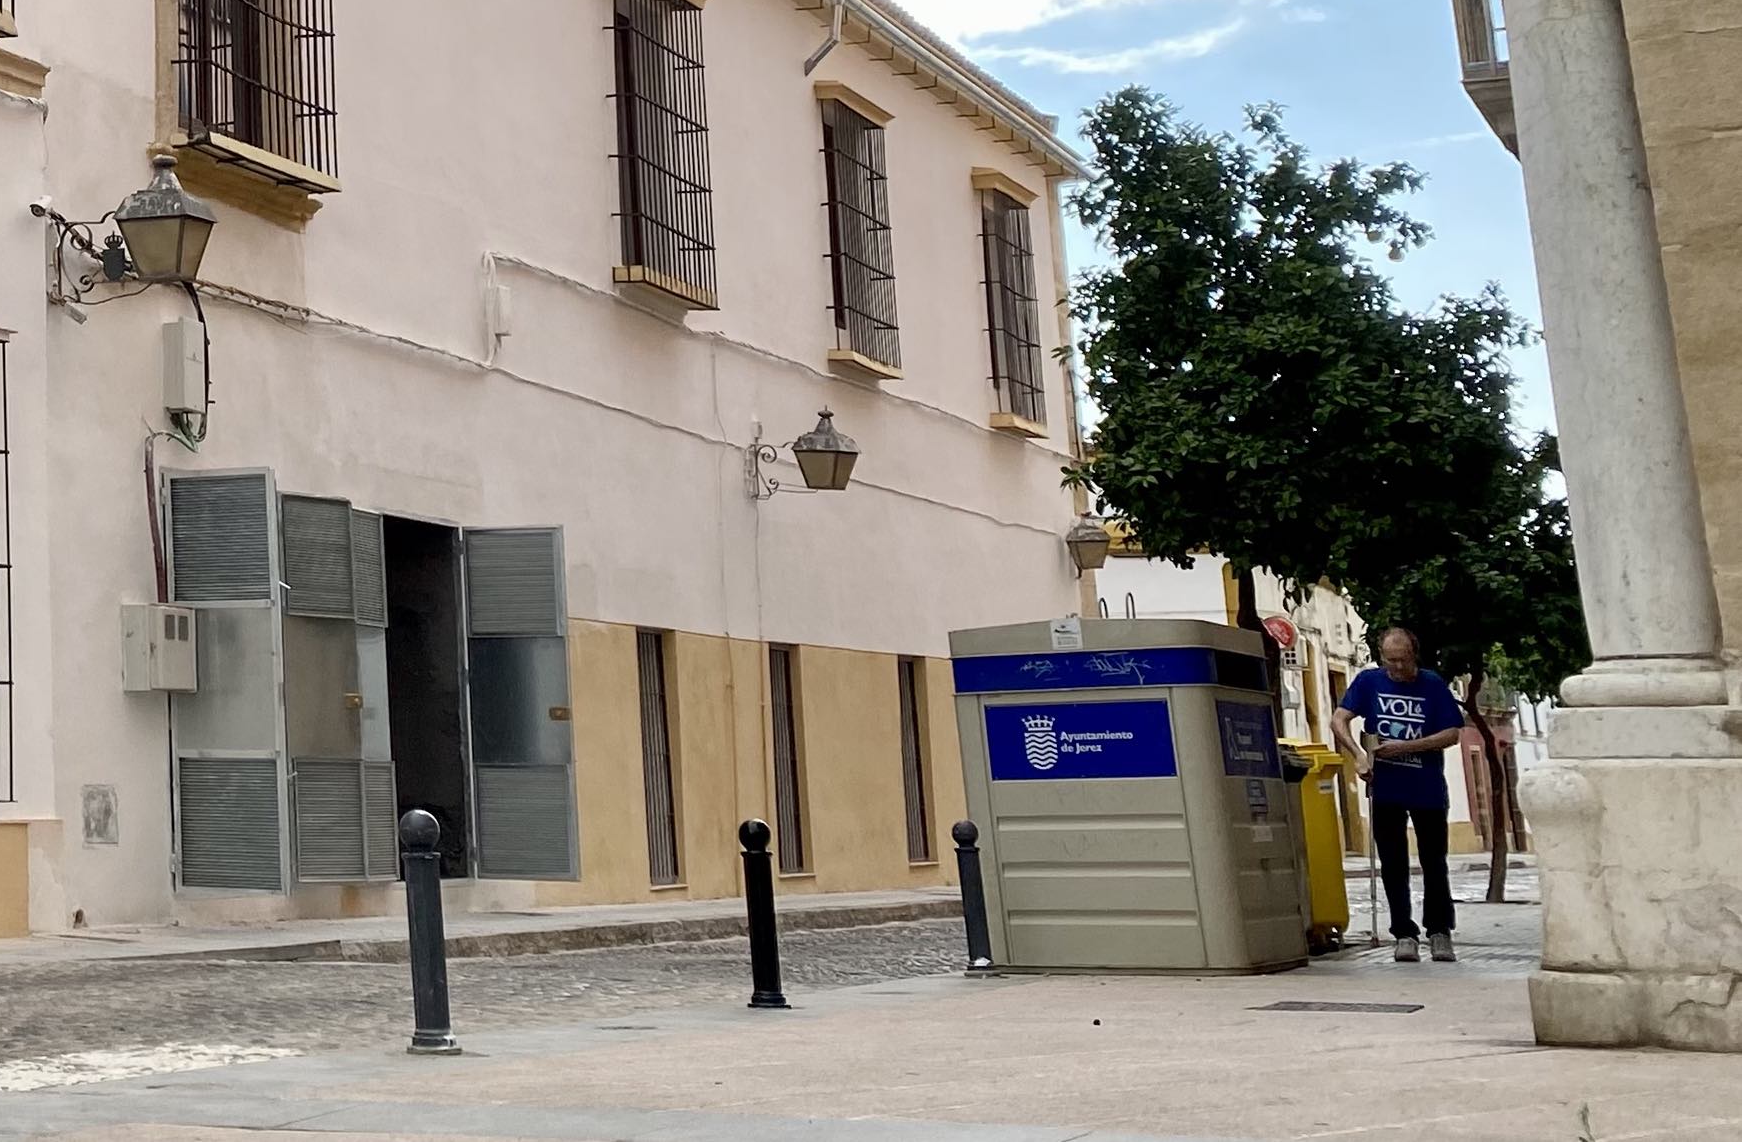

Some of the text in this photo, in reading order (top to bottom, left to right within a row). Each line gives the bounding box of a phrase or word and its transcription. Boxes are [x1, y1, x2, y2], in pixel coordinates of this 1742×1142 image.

[1060, 730, 1134, 743] Ayuntamiento
[1377, 720, 1423, 740] CM
[1060, 743, 1103, 754] de Jerez
